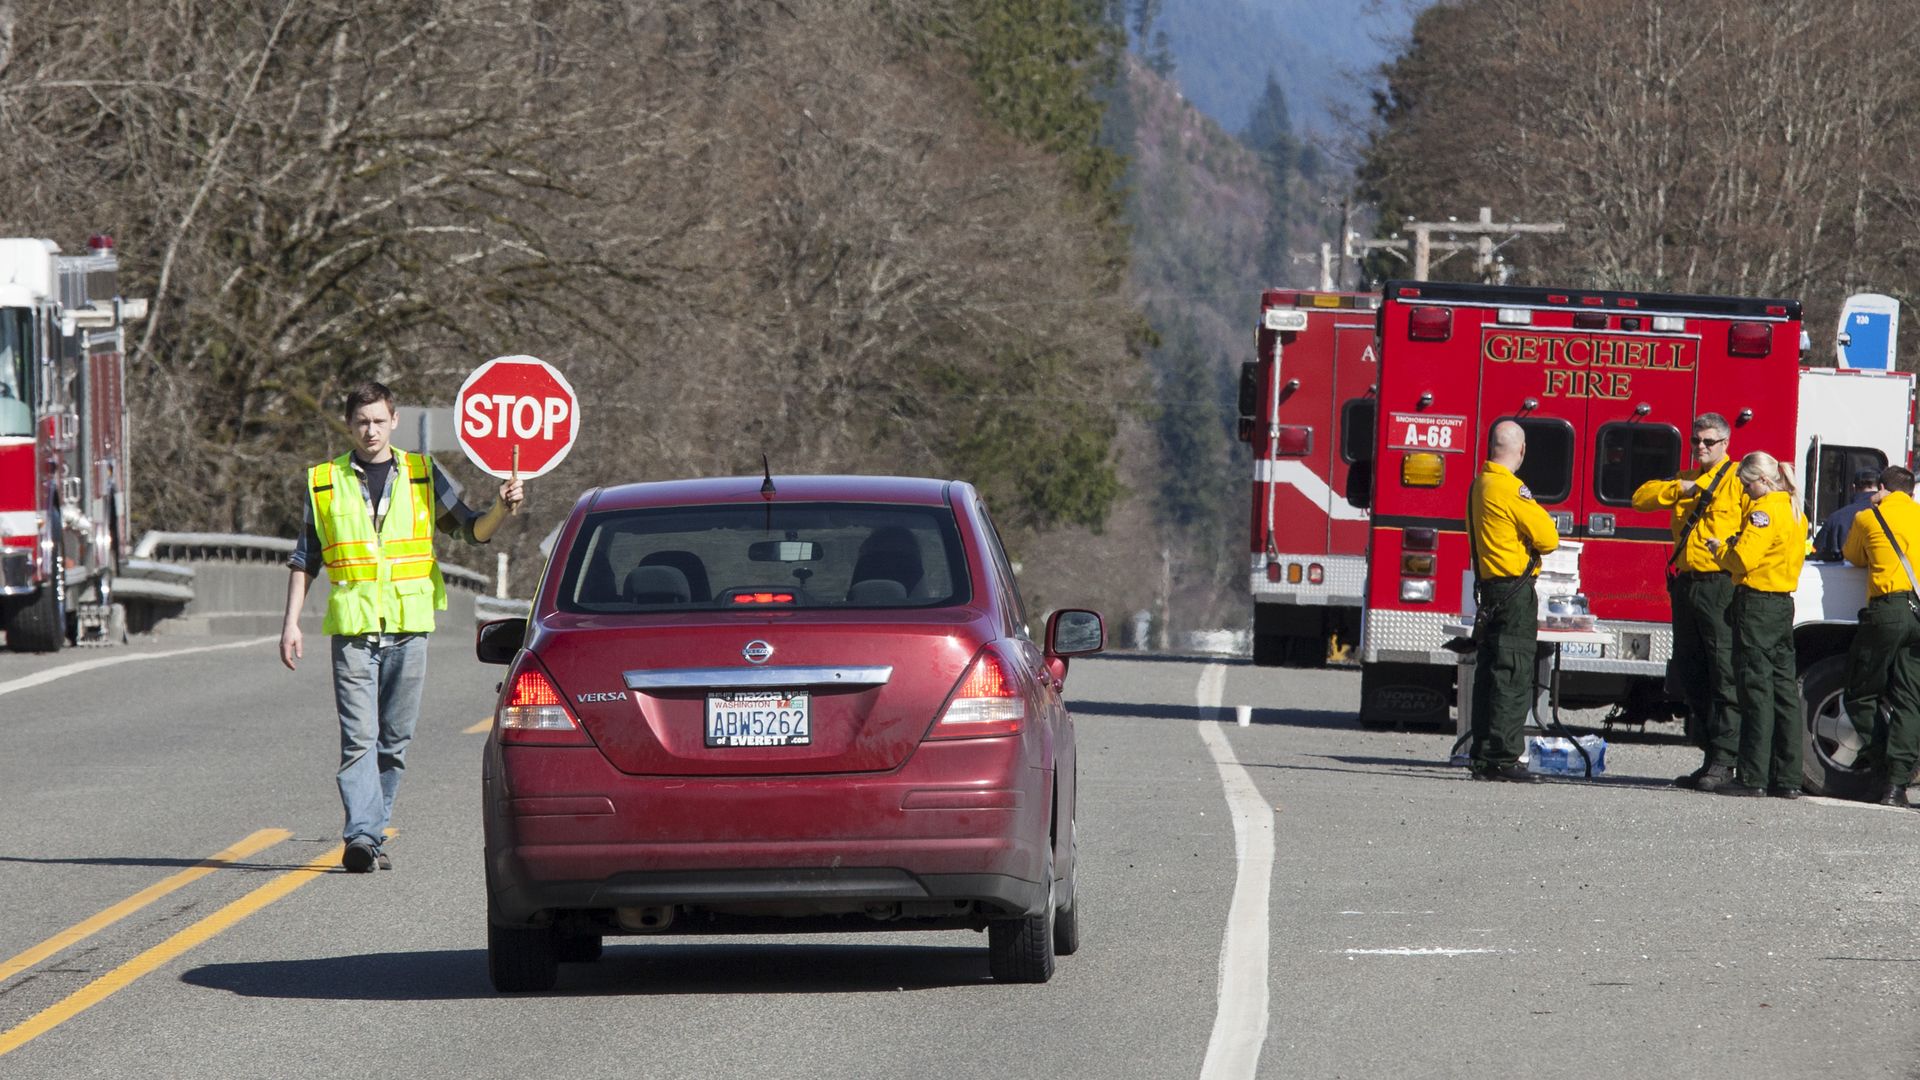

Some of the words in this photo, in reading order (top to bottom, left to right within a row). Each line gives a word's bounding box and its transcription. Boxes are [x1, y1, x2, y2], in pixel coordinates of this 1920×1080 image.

[1485, 334, 1696, 372] GETCHELL
[1542, 368, 1633, 400] FIRE
[464, 393, 569, 440] STOP
[1395, 415, 1435, 425] SNOHOMISH
[1436, 418, 1463, 427] COUNTY
[1405, 423, 1452, 448] A-68
[577, 691, 627, 703] VERSA
[714, 700, 770, 709] WASHINGTON
[714, 710, 804, 736] ABW5262
[716, 737, 726, 745] of
[730, 735, 788, 746] EVERETT
